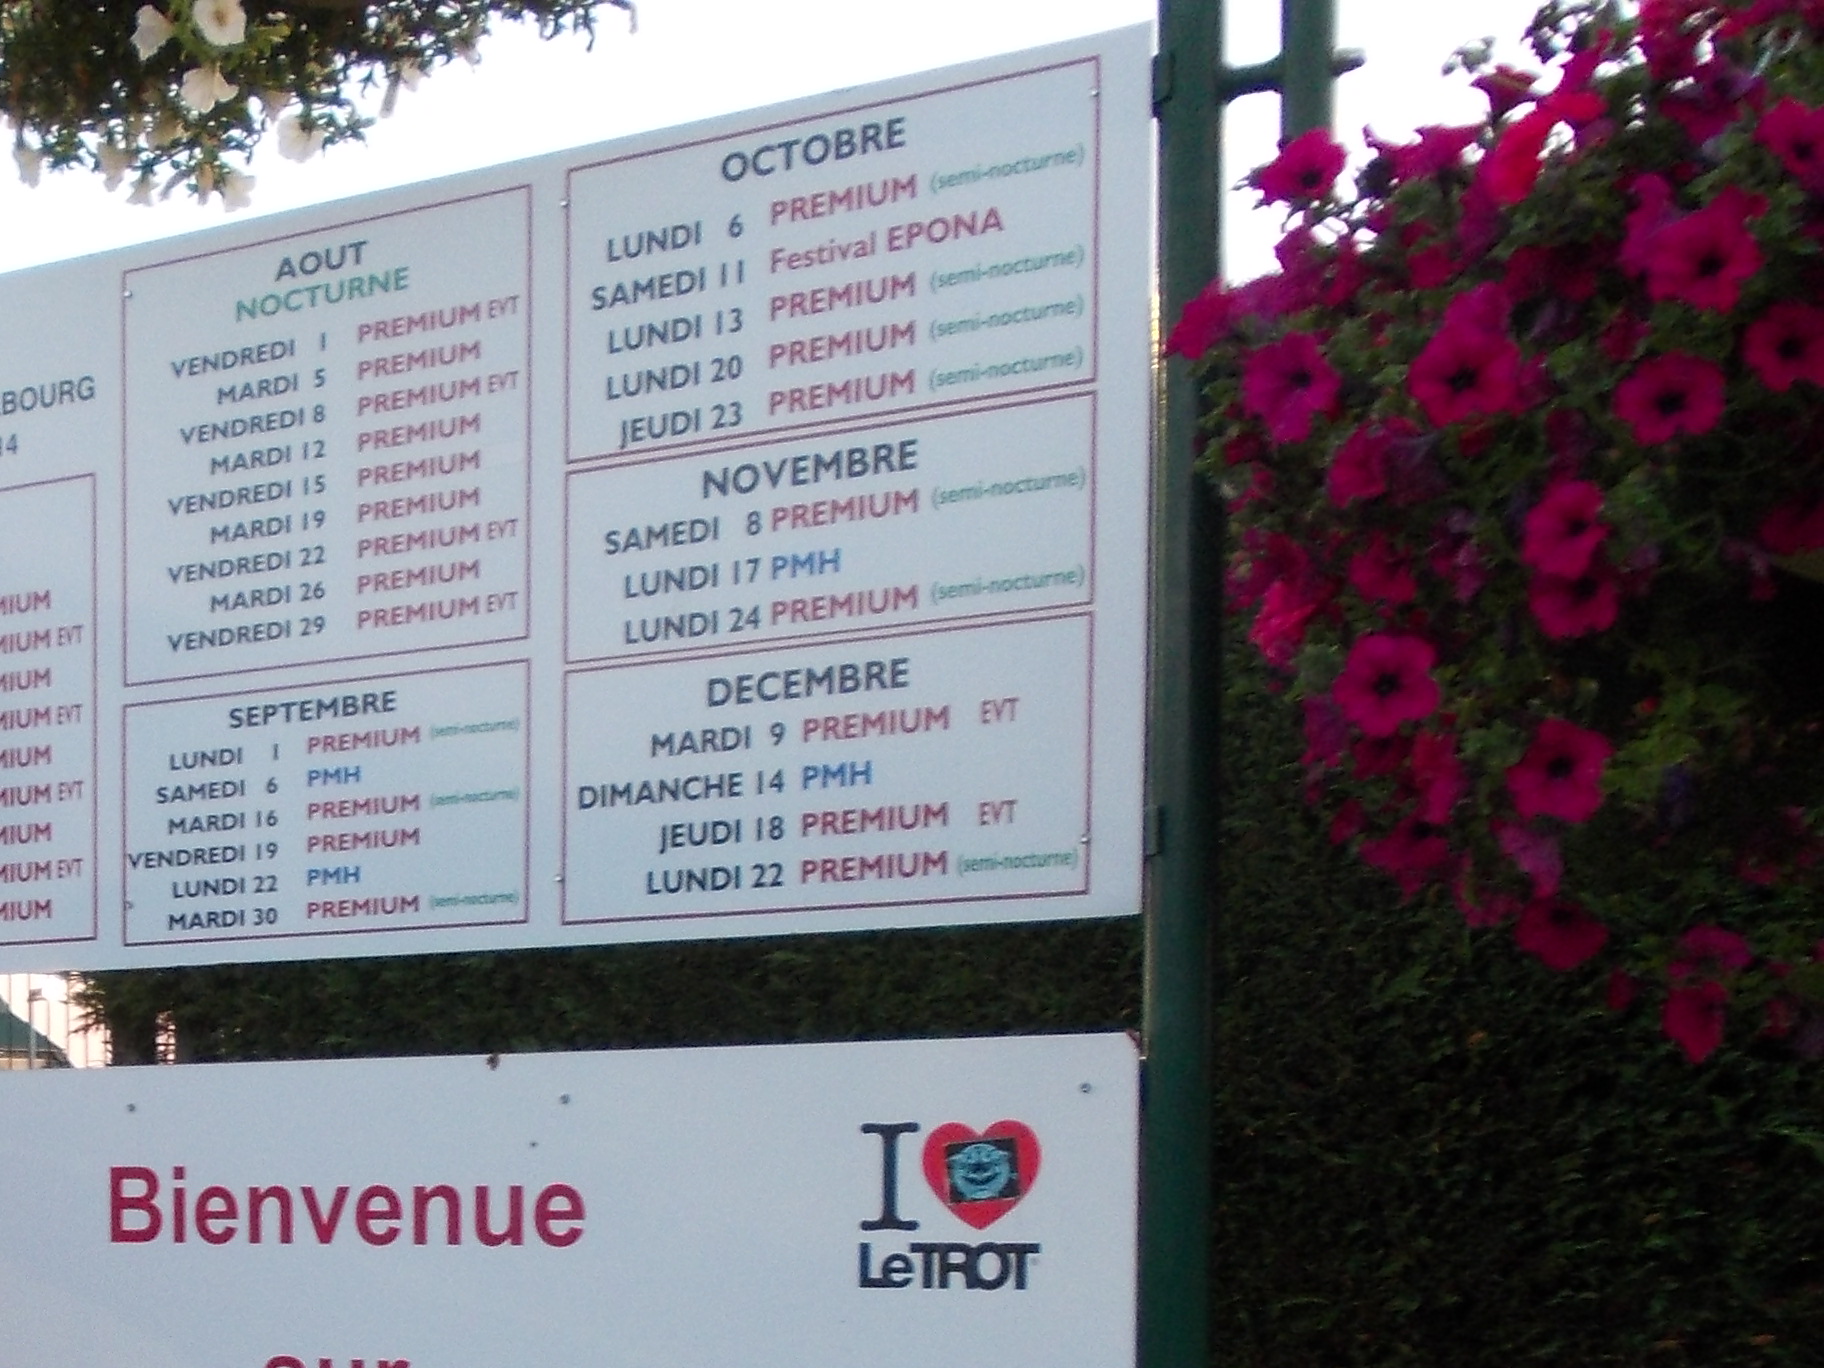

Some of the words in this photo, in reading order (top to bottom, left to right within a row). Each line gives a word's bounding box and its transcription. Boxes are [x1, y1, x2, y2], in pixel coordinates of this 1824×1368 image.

[720, 117, 907, 182] OCTOBRE
[607, 220, 702, 263] LUNDI
[728, 214, 744, 239] 6
[771, 174, 918, 226] PREMIUM
[274, 241, 368, 282] AOUT
[592, 260, 706, 310] SAMEDI
[720, 260, 744, 286] 11
[770, 232, 875, 274] Festival
[887, 206, 1005, 253] EPONA
[235, 267, 410, 322] NOCTURNE
[608, 312, 702, 355] LUNDI
[714, 308, 744, 336] 13
[771, 271, 917, 321] PREMIUM
[171, 338, 296, 379] VENDREDI
[320, 332, 326, 351] 1
[358, 305, 481, 343] PREMIUM
[606, 360, 701, 401] LUNDI
[710, 355, 743, 384] 20
[770, 320, 917, 368] PREMIUM
[217, 373, 299, 405] MARDI
[313, 369, 326, 389] 5
[358, 340, 481, 380] PREMIUM
[180, 407, 305, 445] VENDREDI
[313, 405, 326, 424] 8
[358, 378, 481, 416] PREMIUM
[618, 407, 701, 448] JEUDI
[710, 401, 743, 430] 23
[769, 369, 916, 416] PREMIUM
[210, 444, 292, 476] MARDI
[303, 440, 326, 461] 12
[358, 414, 481, 452] PREMIUM
[702, 439, 919, 499] NOVEMBRE
[168, 480, 293, 516] VENDREDI
[303, 475, 326, 495] 15
[358, 450, 481, 487] PREMIUM
[210, 514, 292, 545] MARDI
[303, 510, 326, 531] 19
[358, 487, 481, 522] PREMIUM
[605, 516, 720, 555] SAMEDI
[746, 511, 762, 536] 8
[772, 488, 919, 532] PREMIUM
[168, 550, 292, 584] VENDREDI
[299, 546, 326, 567] 22
[358, 525, 480, 558] PREMIUM
[624, 562, 720, 599] LUNDI
[733, 557, 762, 585] 17
[772, 548, 841, 581] PMH
[210, 583, 291, 613] MARDI
[300, 579, 326, 600] 26
[358, 560, 480, 594] PREMIUM
[624, 612, 720, 645] LUNDI
[729, 605, 761, 633] 24
[771, 584, 918, 626] PREMIUM
[168, 620, 291, 653] VENDREDI
[299, 616, 326, 636] 29
[358, 597, 480, 629] PREMIUM
[229, 690, 398, 729] SEPTEMBRE
[707, 657, 910, 708] DECEMBRE
[169, 747, 243, 771] LUNDI
[272, 743, 279, 760] 1
[307, 726, 420, 754] PREMIUM
[650, 726, 752, 758] MARDI
[770, 722, 785, 747] 9
[802, 704, 949, 743] PREMIUM
[156, 780, 246, 804] SAMEDI
[266, 777, 278, 794] 6
[307, 765, 361, 787] PMH
[578, 772, 743, 811] DIMANCHE
[755, 769, 784, 795] 14
[802, 761, 873, 791] PMH
[168, 813, 246, 835] MARDI
[255, 810, 278, 828] 16
[307, 794, 420, 820] PREMIUM
[658, 817, 742, 855] JEUDI
[754, 815, 784, 842] 18
[802, 801, 948, 838] PREMIUM
[128, 845, 246, 869] VENDREDI
[255, 842, 278, 860] 19
[307, 827, 420, 853] PREMIUM
[646, 867, 742, 896] LUNDI
[751, 863, 783, 888] 22
[801, 851, 947, 885] PREMIUM
[172, 878, 246, 899] LUNDI
[254, 875, 278, 893] 22
[306, 866, 361, 886] PMH
[168, 909, 246, 931] MARDI
[253, 907, 278, 925] 30
[306, 895, 420, 919] PREMIUM
[860, 1122, 920, 1230] I
[107, 1165, 587, 1250] Bienvenue
[859, 1243, 1040, 1290] LeTROT
